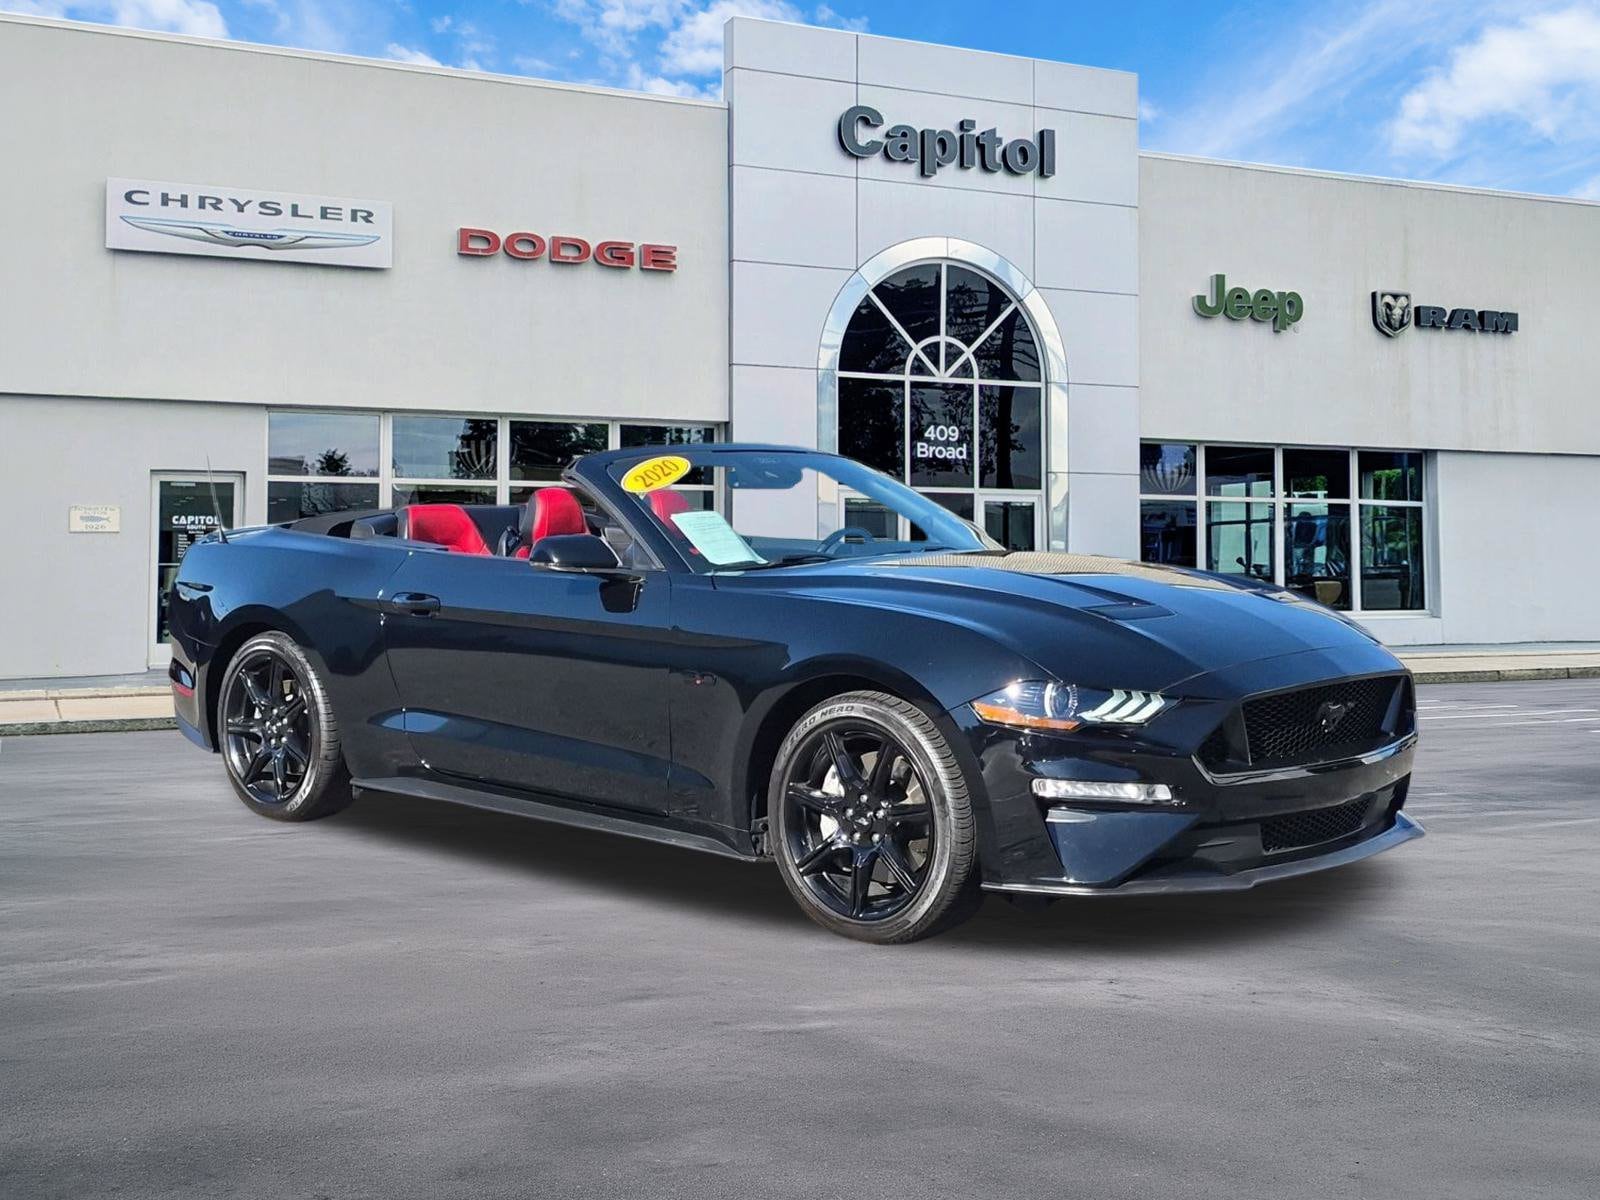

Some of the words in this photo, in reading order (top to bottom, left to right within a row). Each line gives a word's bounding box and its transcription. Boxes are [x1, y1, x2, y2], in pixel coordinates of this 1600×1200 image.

[838, 105, 1056, 178] Capitol
[123, 189, 375, 224] CHRYSLER
[457, 227, 678, 272] DODGE
[1192, 273, 1304, 333] Jeep
[1414, 305, 1519, 333] RAM
[924, 425, 960, 442] 409
[916, 441, 967, 460] Broad
[635, 460, 680, 488] 2020
[172, 515, 220, 525] CAPITOL
